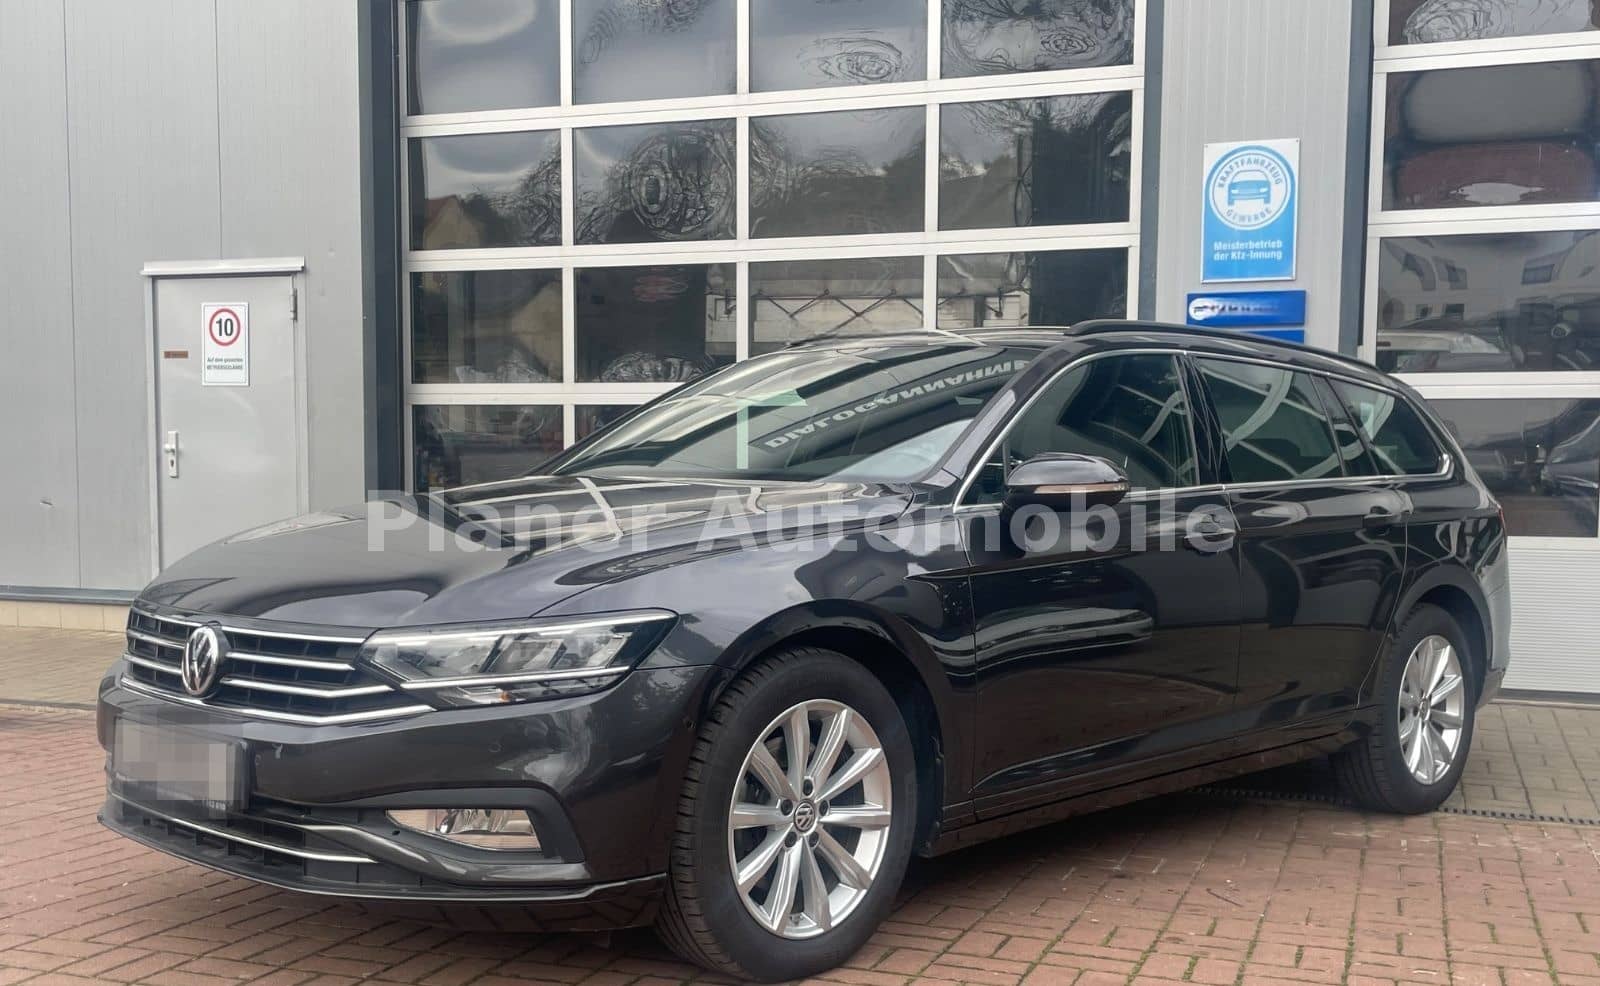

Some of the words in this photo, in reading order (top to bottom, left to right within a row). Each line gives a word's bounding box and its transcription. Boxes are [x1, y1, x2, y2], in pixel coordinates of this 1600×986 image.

[1218, 157, 1282, 187] KRAFTFAHRZEUG
[1226, 207, 1272, 222] GEWERBE
[1213, 239, 1283, 251] Meisterbetrieb
[1213, 251, 1229, 261] der
[1230, 249, 1283, 261] Kfz-Innung
[215, 318, 234, 336] 10
